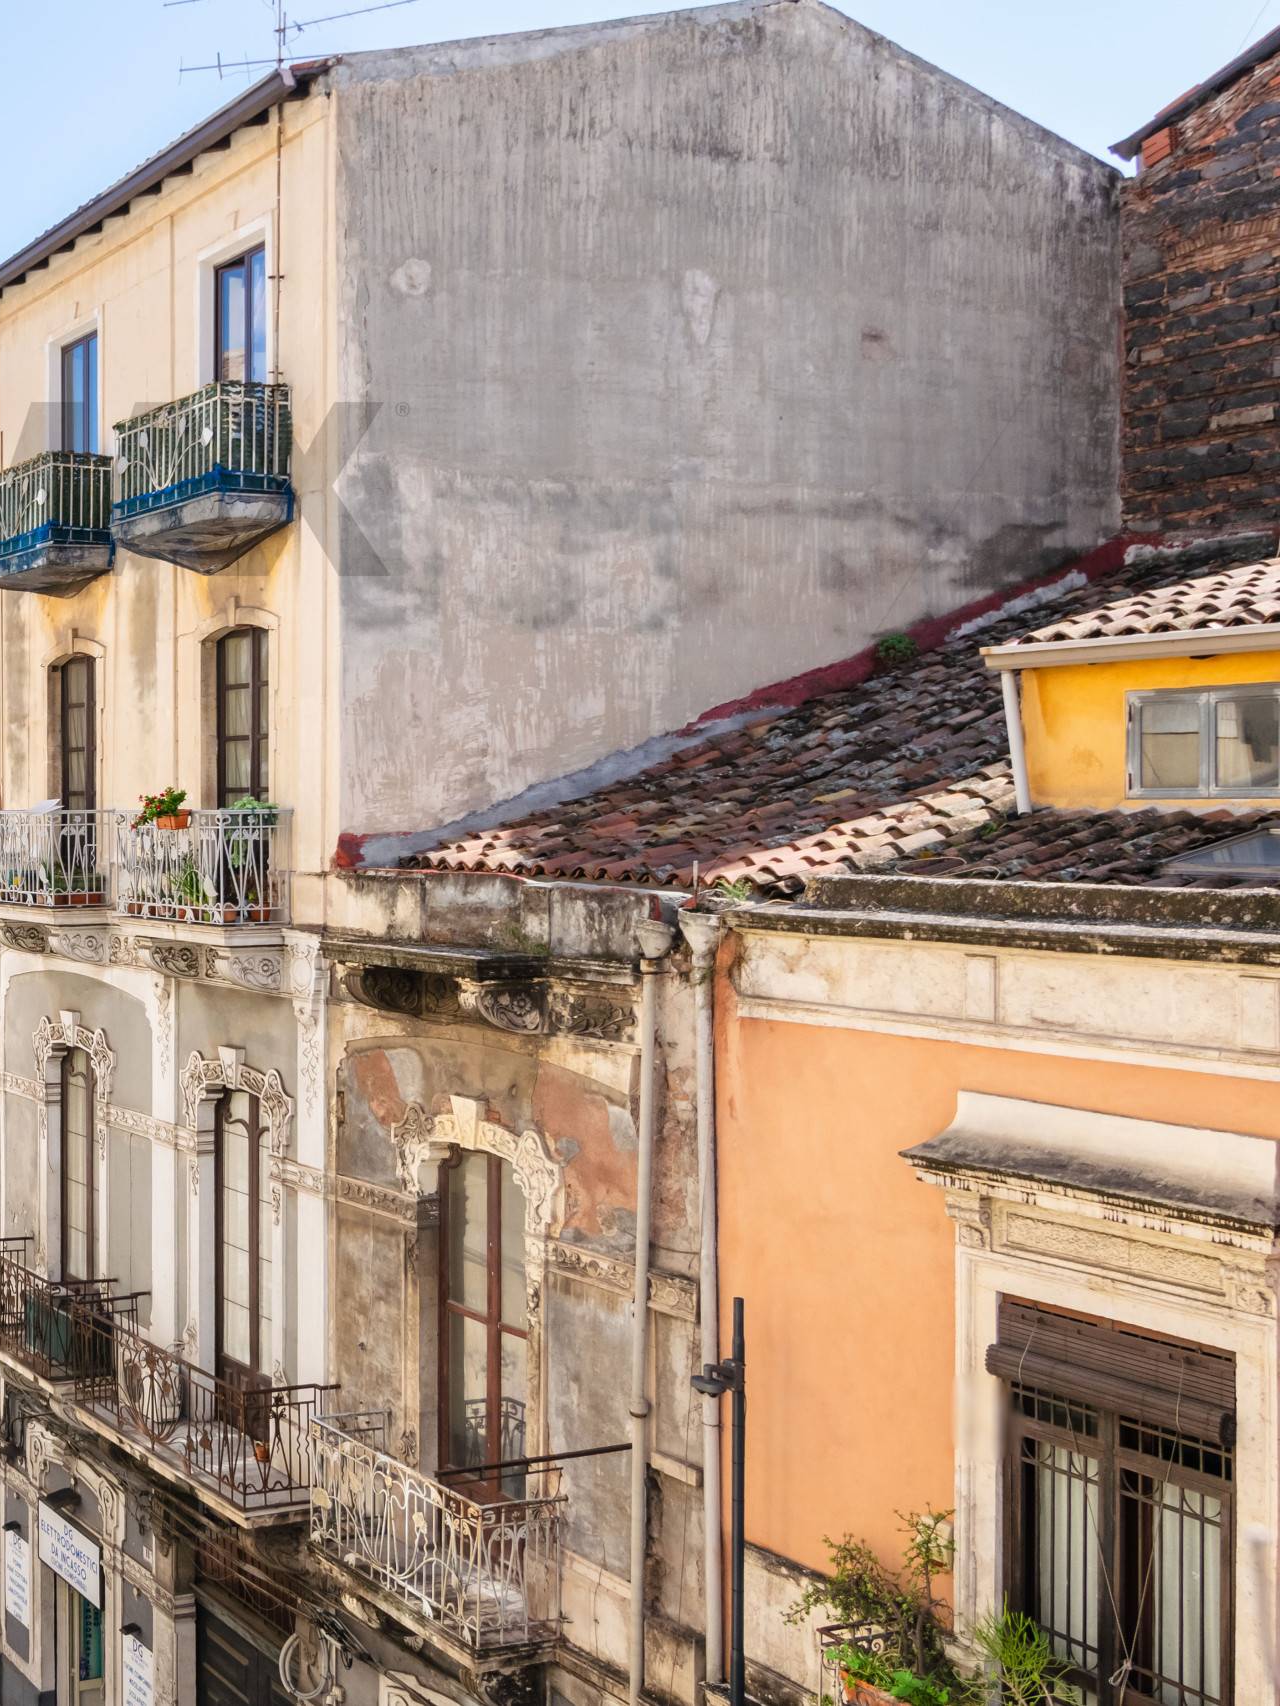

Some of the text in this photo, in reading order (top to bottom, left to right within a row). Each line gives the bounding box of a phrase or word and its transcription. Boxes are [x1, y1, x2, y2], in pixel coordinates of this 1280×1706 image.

[63, 1524, 73, 1540] DG
[40, 1519, 98, 1575] ELETTRODOMESTICI
[51, 1542, 59, 1557] DA
[60, 1551, 87, 1580] INCASSO
[132, 1638, 143, 1658] DG
